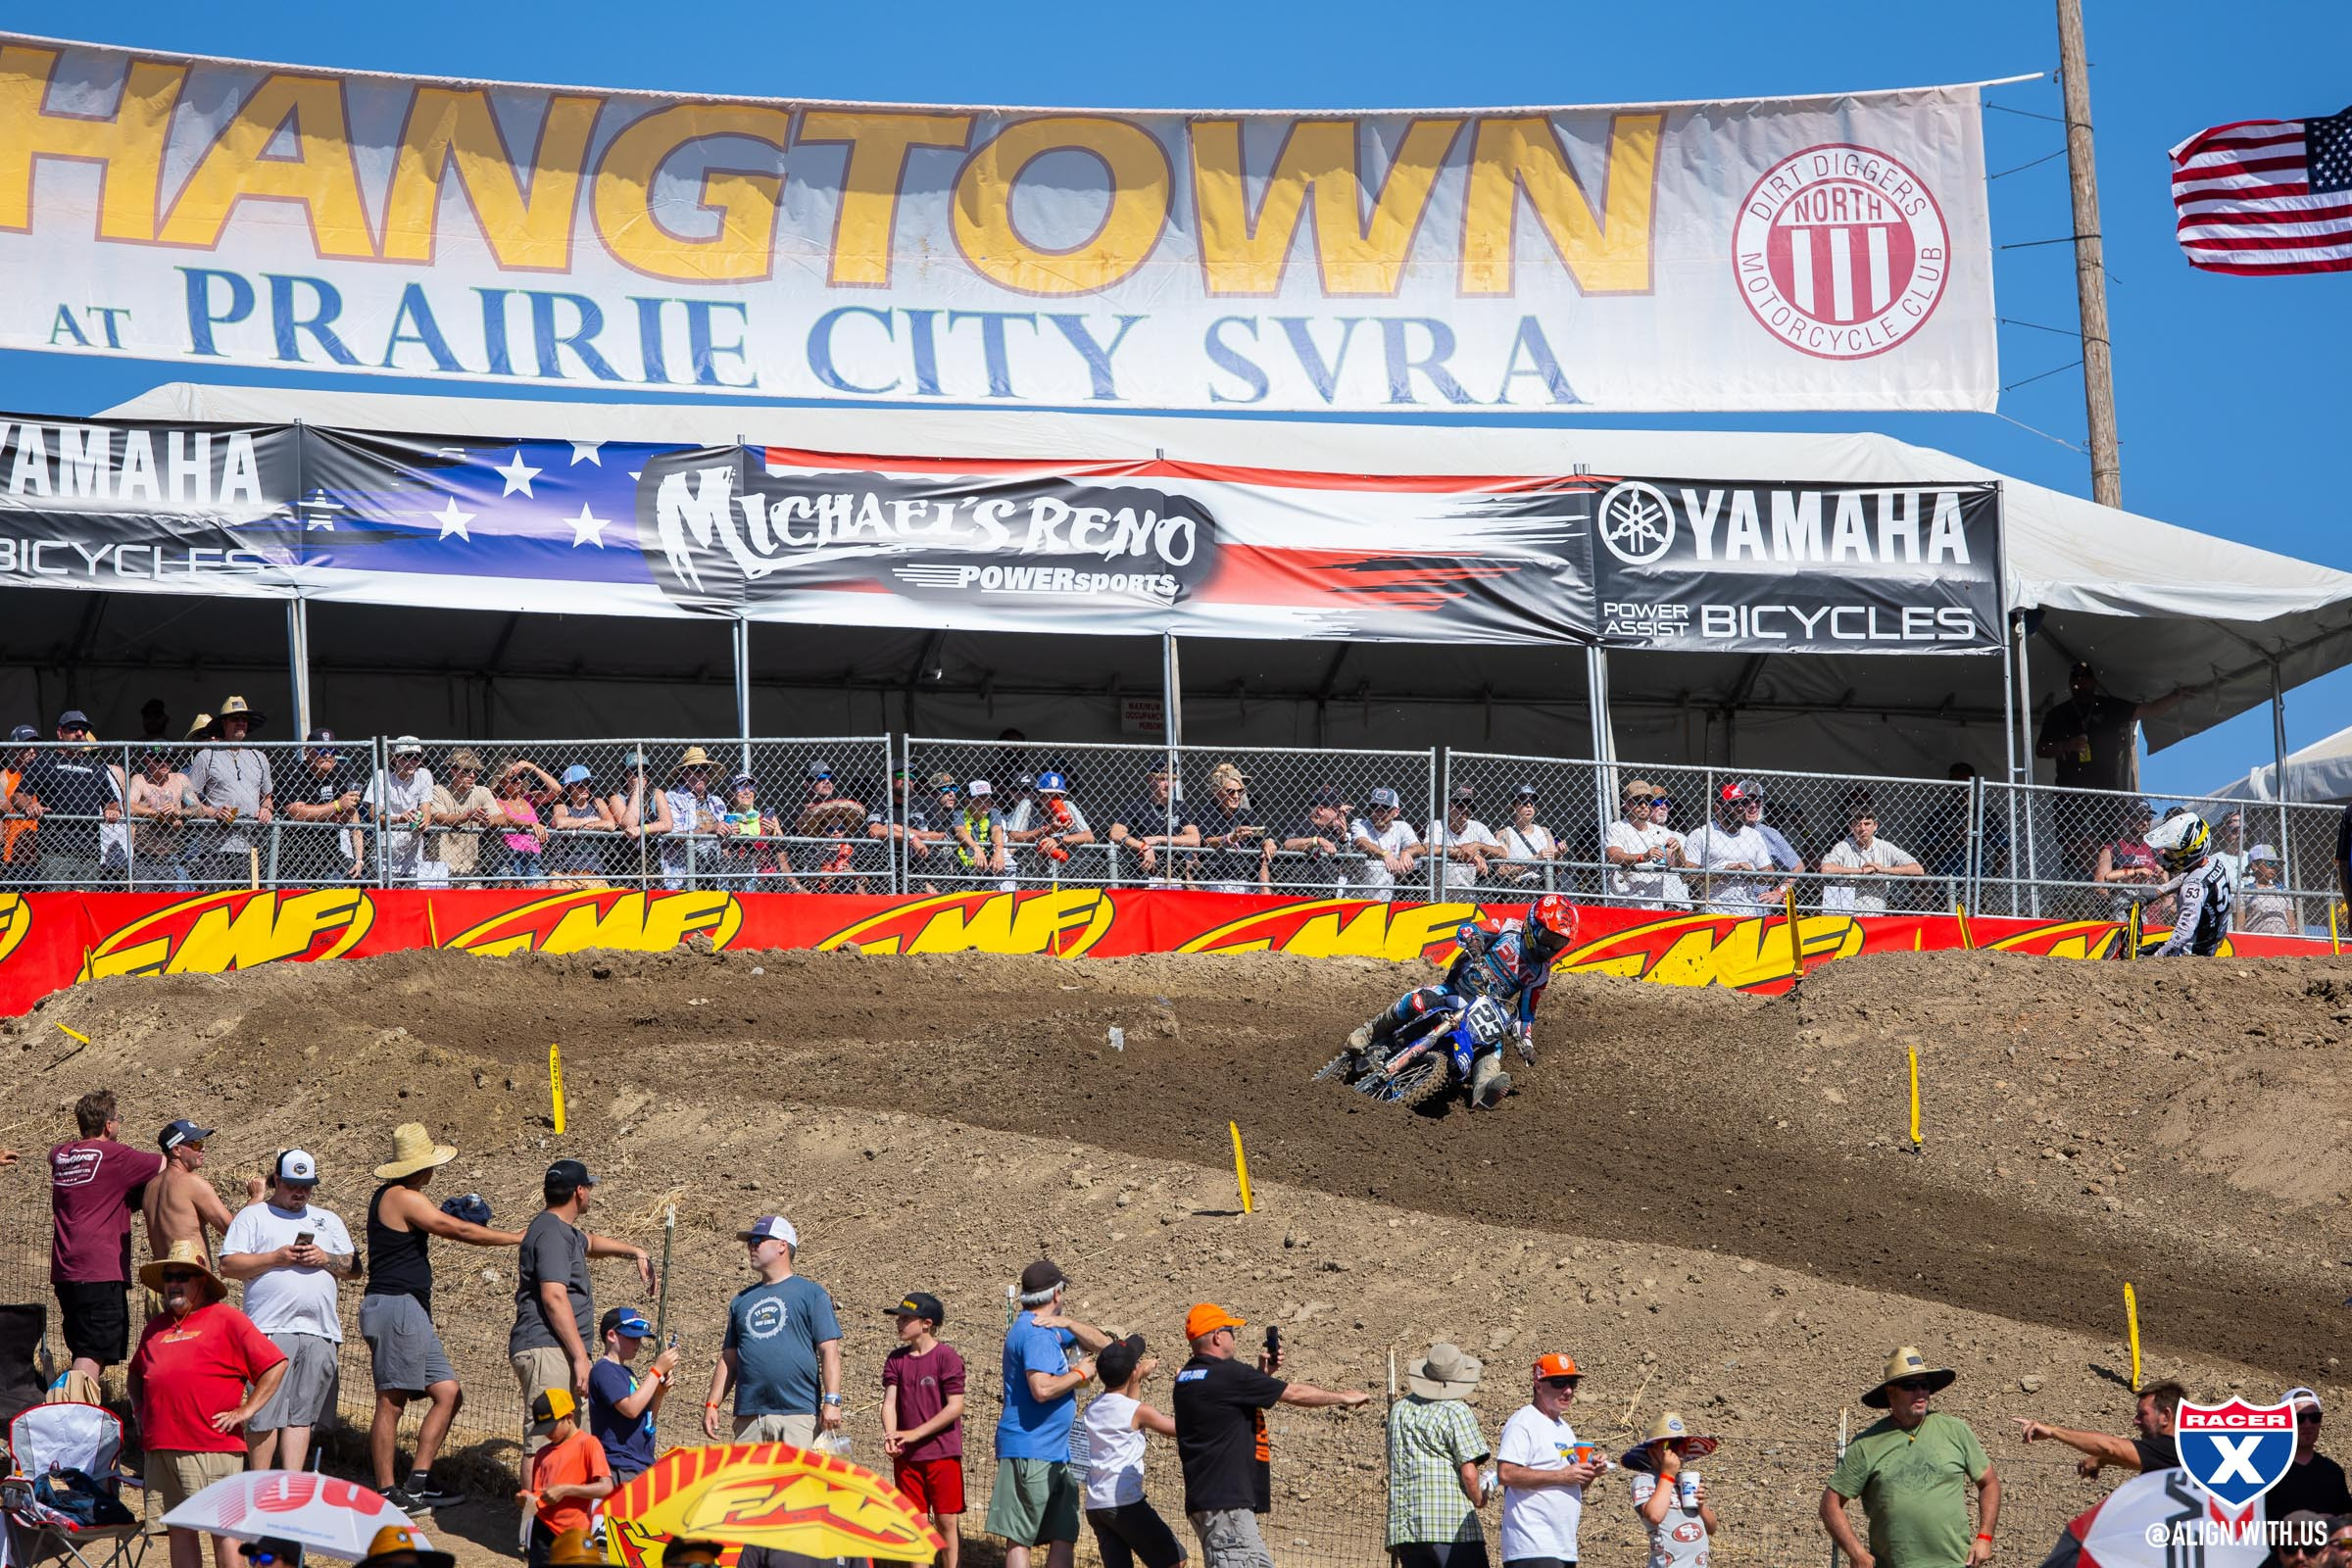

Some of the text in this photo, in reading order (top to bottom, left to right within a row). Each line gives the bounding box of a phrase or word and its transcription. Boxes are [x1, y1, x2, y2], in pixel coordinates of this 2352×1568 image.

[0, 42, 1669, 299] HANGTOWN
[1749, 153, 1927, 221] DIRT DIGGERS
[1793, 186, 1883, 223] NORTH
[1741, 247, 1942, 352] MOTORCYCLE CLUB
[47, 266, 1595, 407] AT PRAIRIE CITY SVRA
[1019, 496, 1197, 567] RENO
[1680, 488, 1972, 565] YAMAHA
[1604, 602, 1689, 619] POWER
[1604, 620, 1690, 638] ASSIST
[1701, 604, 1977, 641] BICYCLES
[2185, 887, 2200, 899] 53
[1468, 1004, 1500, 1043] 23
